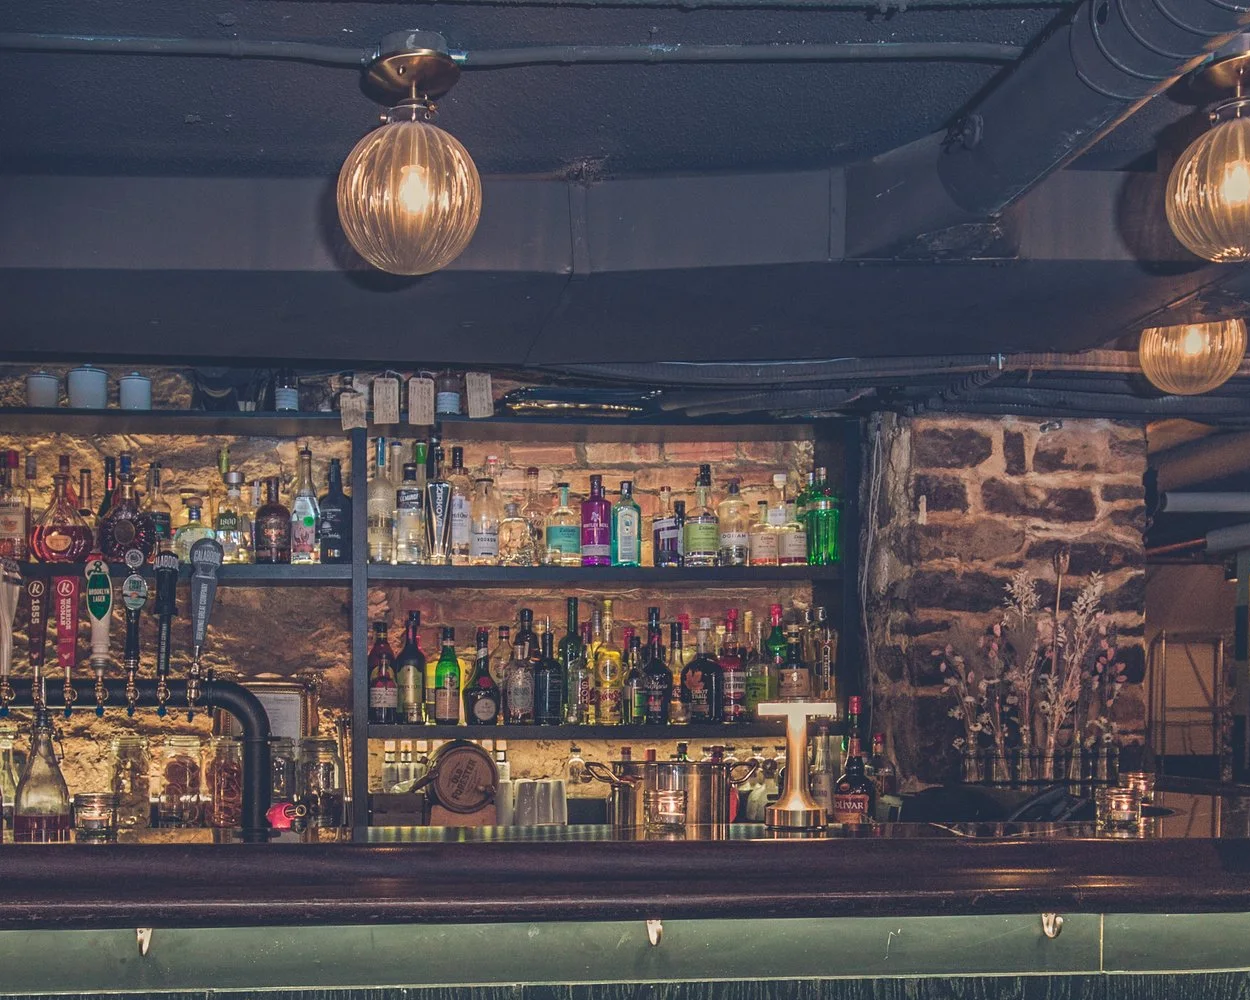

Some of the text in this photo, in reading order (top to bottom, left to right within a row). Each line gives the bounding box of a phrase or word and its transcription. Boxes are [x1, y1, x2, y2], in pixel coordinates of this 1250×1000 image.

[220, 517, 236, 525] 1800
[88, 588, 110, 596] BROOKLYN
[200, 583, 208, 605] COMPANY
[31, 599, 40, 624] 1855
[198, 605, 207, 619] GREAT
[451, 768, 463, 785] OLD
[451, 758, 478, 800] FORESTER
